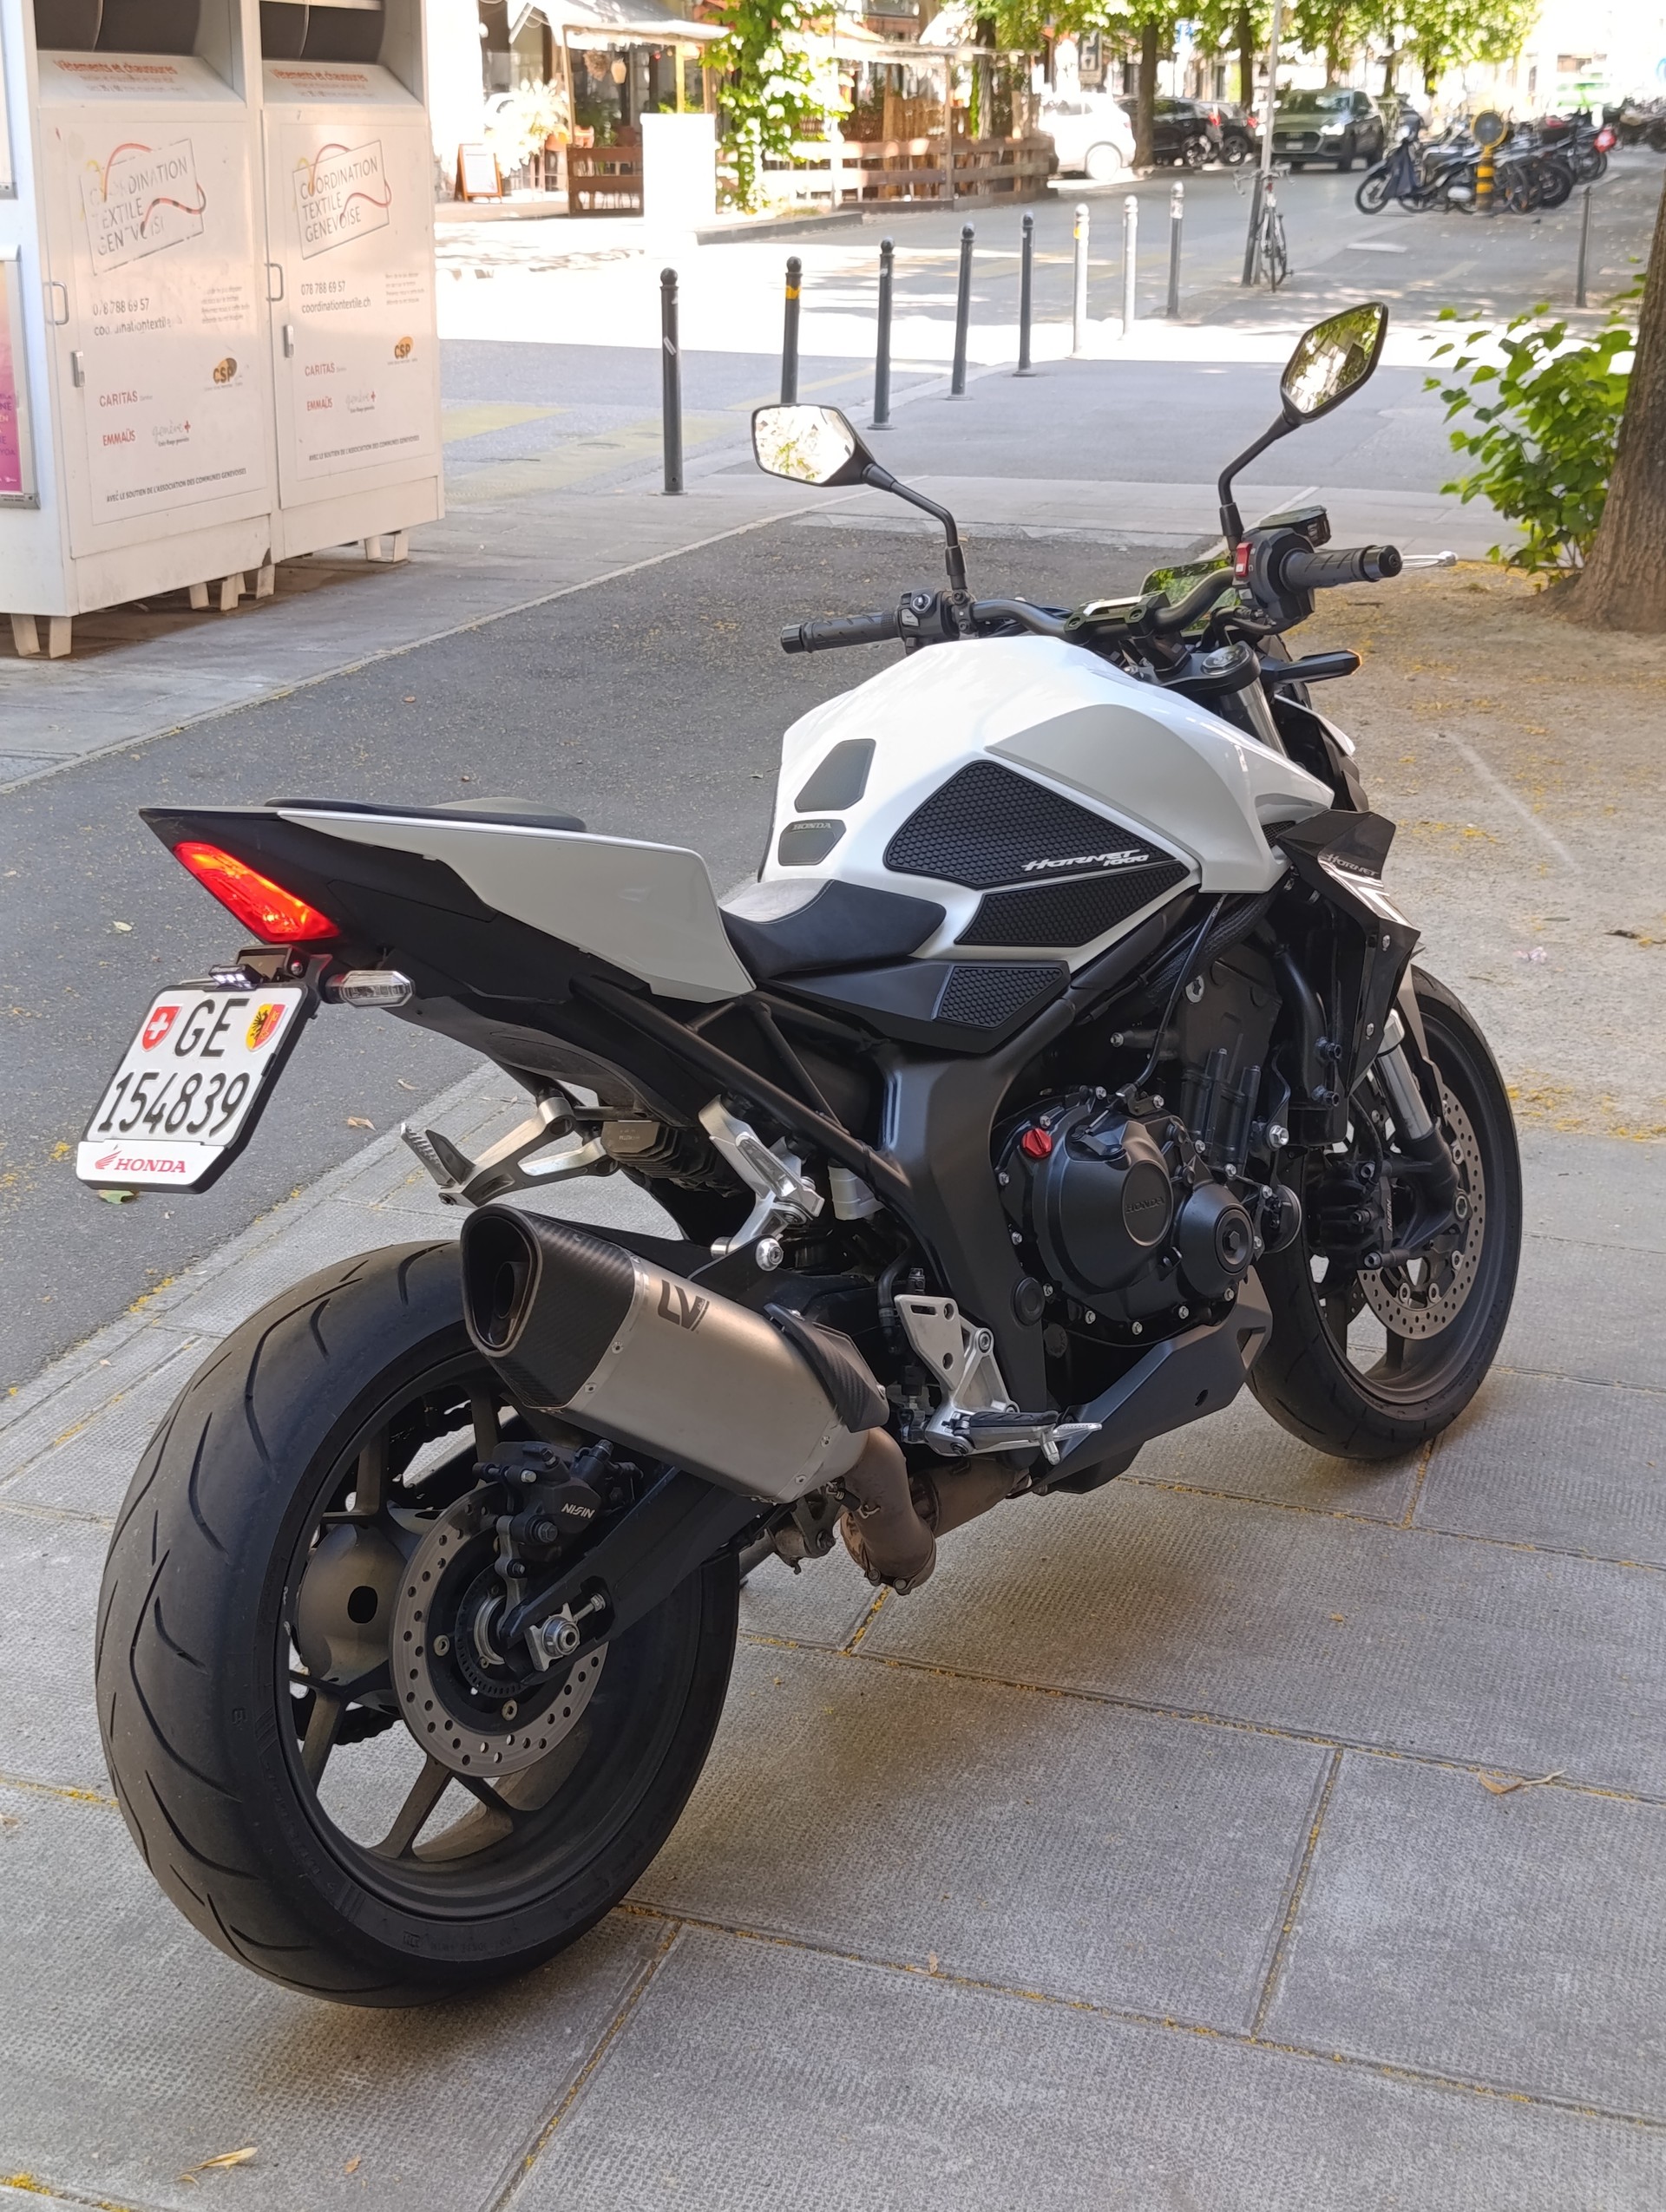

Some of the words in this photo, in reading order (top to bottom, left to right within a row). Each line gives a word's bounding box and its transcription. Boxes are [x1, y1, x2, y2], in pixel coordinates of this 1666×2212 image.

[300, 156, 378, 200] COORDINATION
[302, 192, 343, 221] TEXTILE
[305, 206, 362, 243] GENEVOISE
[300, 284, 313, 296] 078
[315, 282, 327, 295] 788
[329, 281, 337, 293] 69
[338, 280, 345, 292] 57
[110, 300, 127, 314] 788
[128, 299, 139, 312] 69
[140, 298, 150, 311] 57
[301, 296, 371, 313] coordinationtextile.ch
[394, 344, 410, 359] CSP
[213, 366, 233, 384] CSP
[305, 363, 336, 376] CARITAS
[99, 390, 138, 407] CARITAS
[126, 488, 146, 499] SOUTIEN
[195, 473, 220, 485] COMMUNES
[221, 468, 246, 480] GENEVOISES
[791, 822, 831, 831] HONDA
[1021, 848, 1140, 872] HORNET
[1103, 854, 1150, 867] 1000
[1327, 854, 1380, 876] HORNET
[174, 998, 251, 1058] GE
[96, 1071, 251, 1138] 154839
[114, 1158, 187, 1174] HONDA
[1125, 1197, 1164, 1214] HONDA
[658, 1279, 706, 1330] LV
